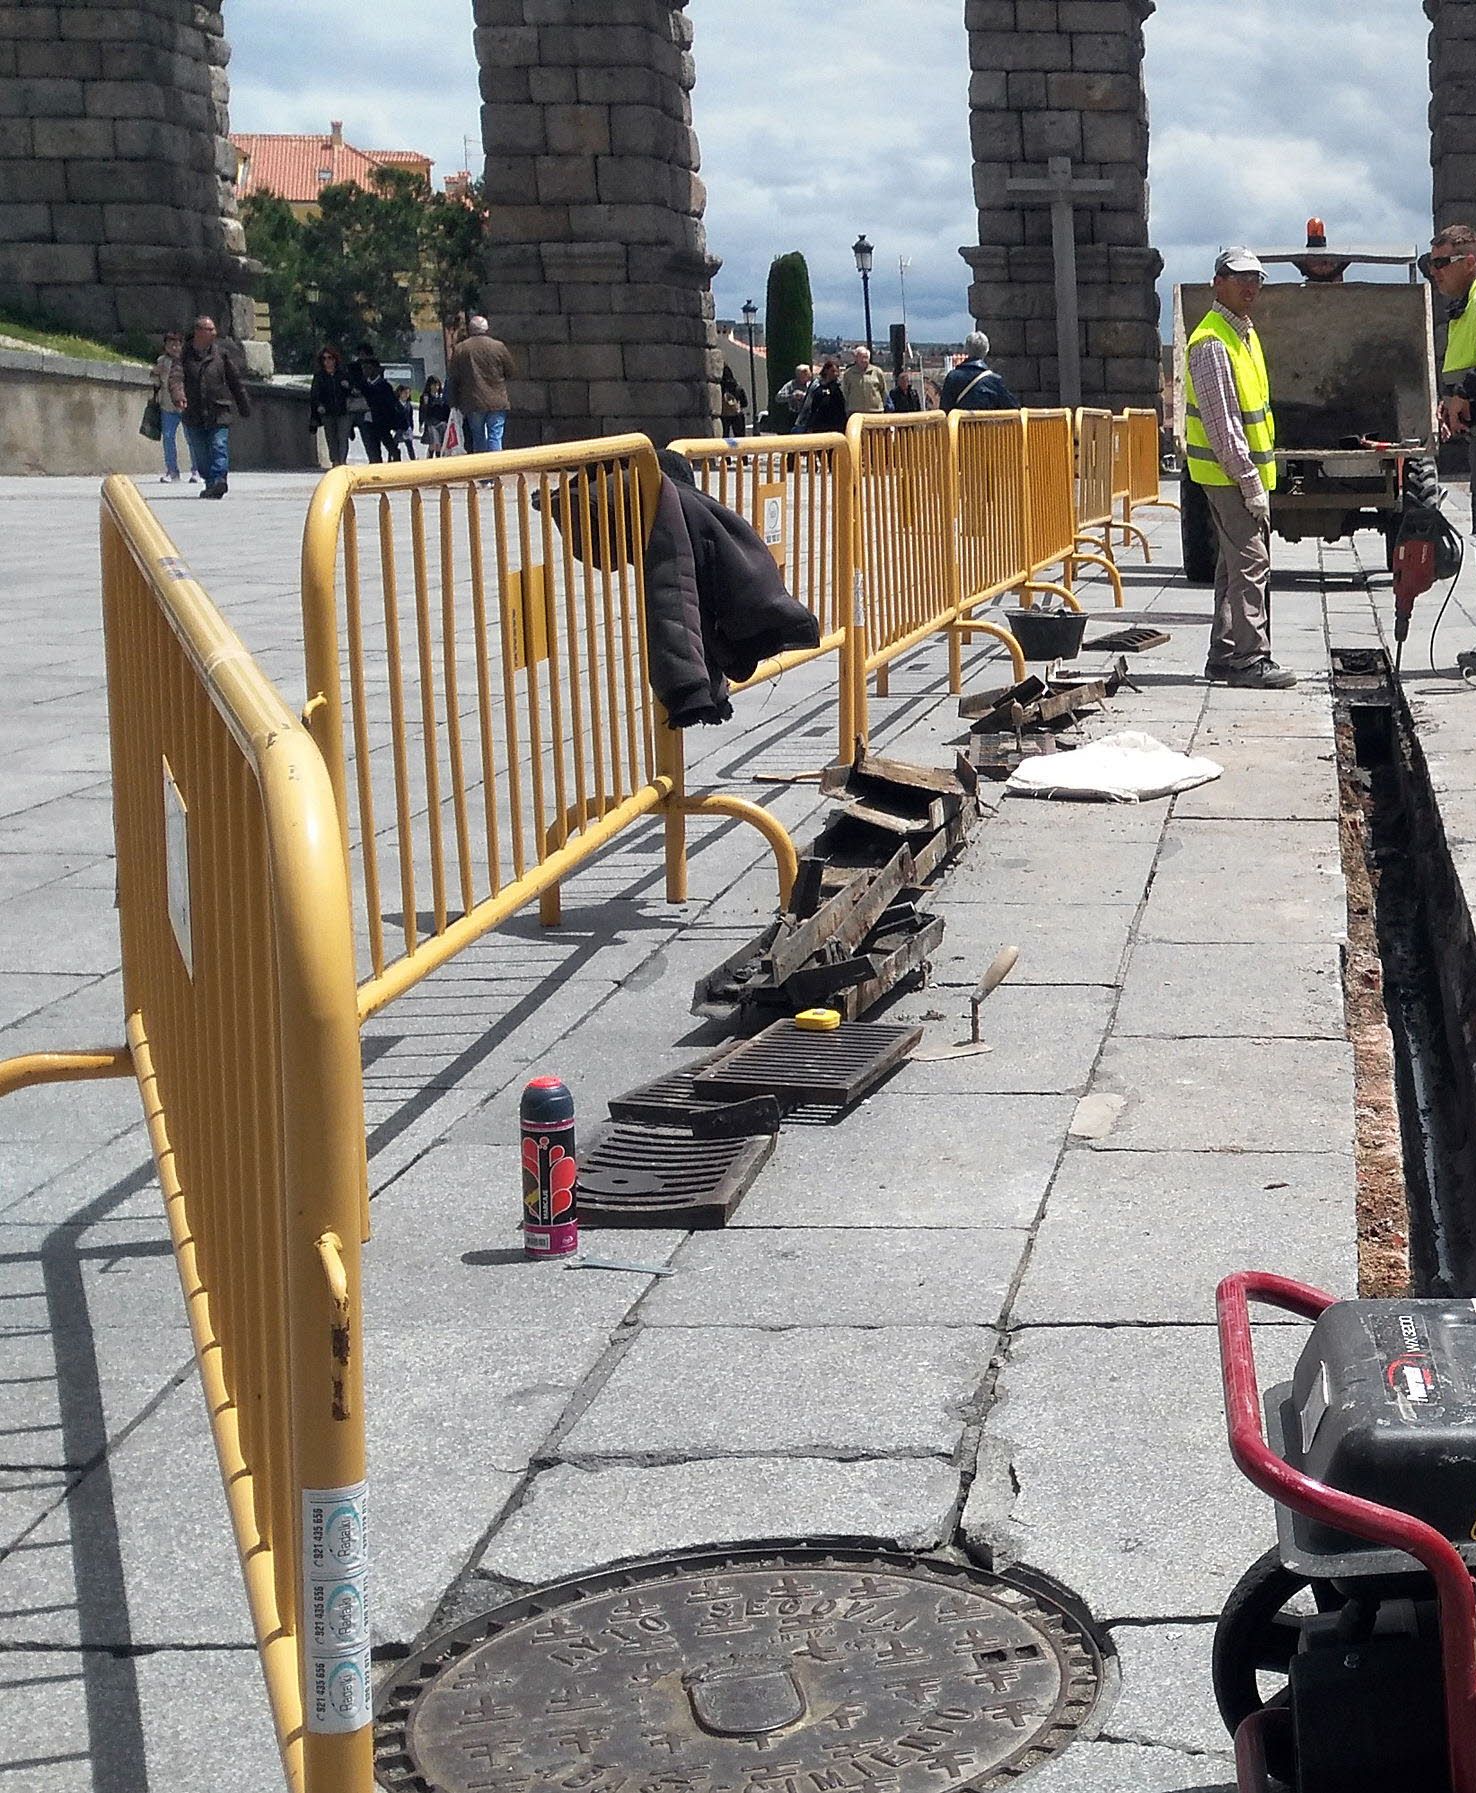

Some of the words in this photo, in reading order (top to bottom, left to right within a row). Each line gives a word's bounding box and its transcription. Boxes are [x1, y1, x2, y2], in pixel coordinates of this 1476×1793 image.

[312, 1508, 322, 1524] 656
[313, 1525, 323, 1541] 435
[337, 1519, 352, 1556] Radalki
[313, 1543, 324, 1560] 921
[313, 1586, 324, 1602] 656
[314, 1603, 324, 1619] 435
[338, 1597, 353, 1634] Radalki
[709, 1597, 920, 1634] SEGOVIA
[314, 1621, 325, 1637] 921
[315, 1663, 325, 1679] 656
[315, 1680, 325, 1696] 435
[339, 1675, 353, 1711] Radalki
[315, 1697, 326, 1713] 921
